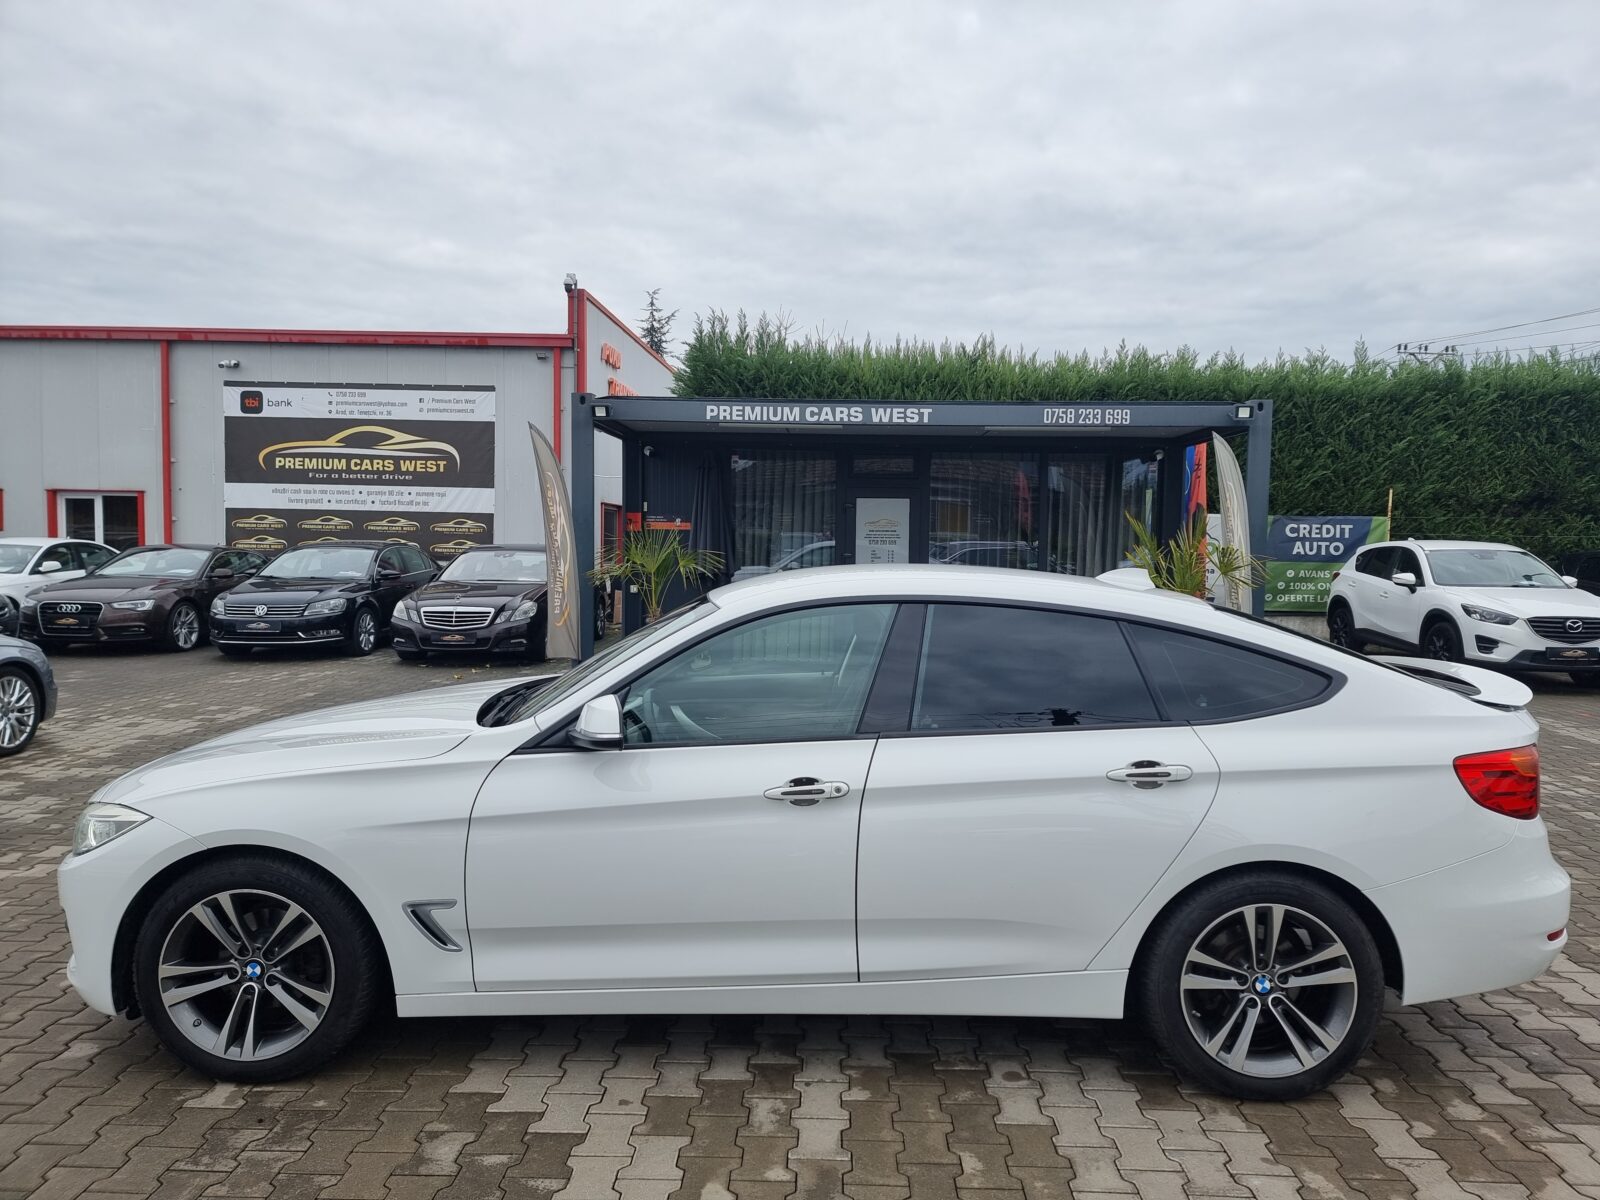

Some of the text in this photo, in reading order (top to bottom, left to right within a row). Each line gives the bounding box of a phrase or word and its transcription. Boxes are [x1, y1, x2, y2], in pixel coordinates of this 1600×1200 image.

[244, 397, 293, 408] tbi bank
[705, 405, 933, 424] PREMIUM CARS WEST
[1043, 408, 1131, 425] 0758 233 699
[275, 457, 447, 473] PREMIUM CARS WEST
[342, 472, 378, 480] better
[1285, 523, 1354, 539] CREDIT
[1292, 541, 1345, 556] AUTO
[1298, 570, 1331, 578] AVANS
[1289, 582, 1316, 590] 100%
[1276, 594, 1315, 603] OFERTE
